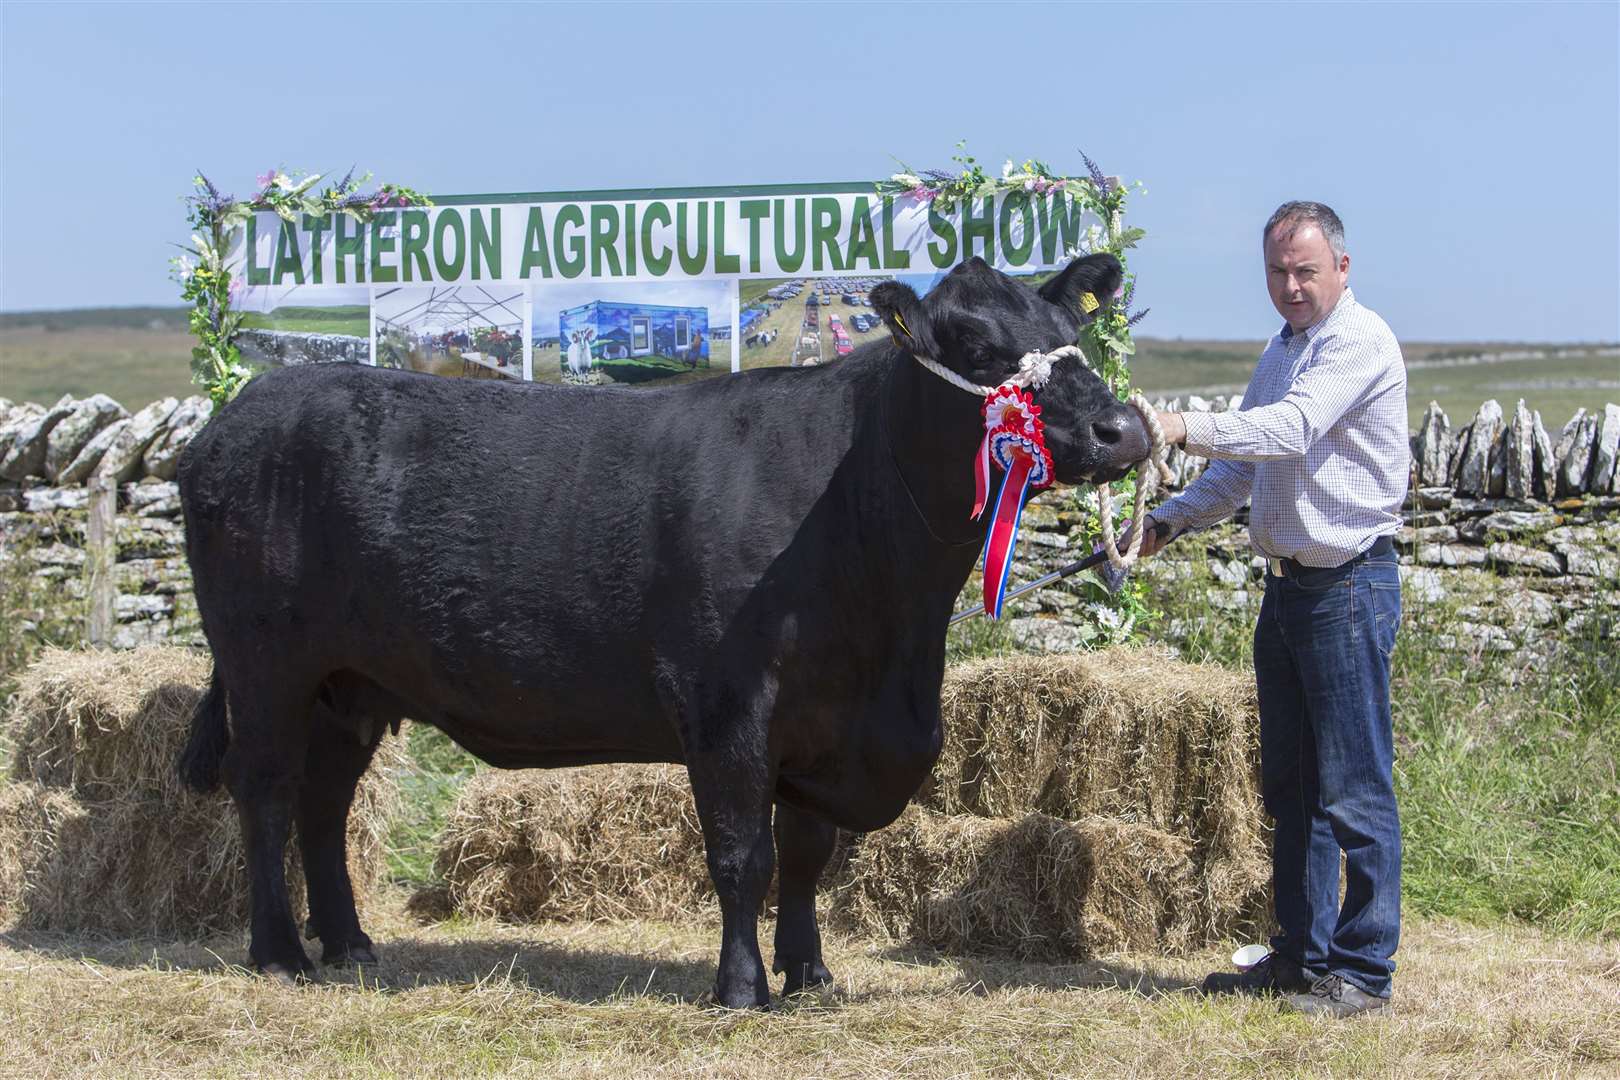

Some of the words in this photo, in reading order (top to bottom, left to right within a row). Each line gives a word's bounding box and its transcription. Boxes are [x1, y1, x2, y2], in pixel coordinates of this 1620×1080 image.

[247, 207, 501, 285] LATHERON
[520, 196, 910, 280] AGRICULTURAL
[928, 189, 1081, 268] SHOW
